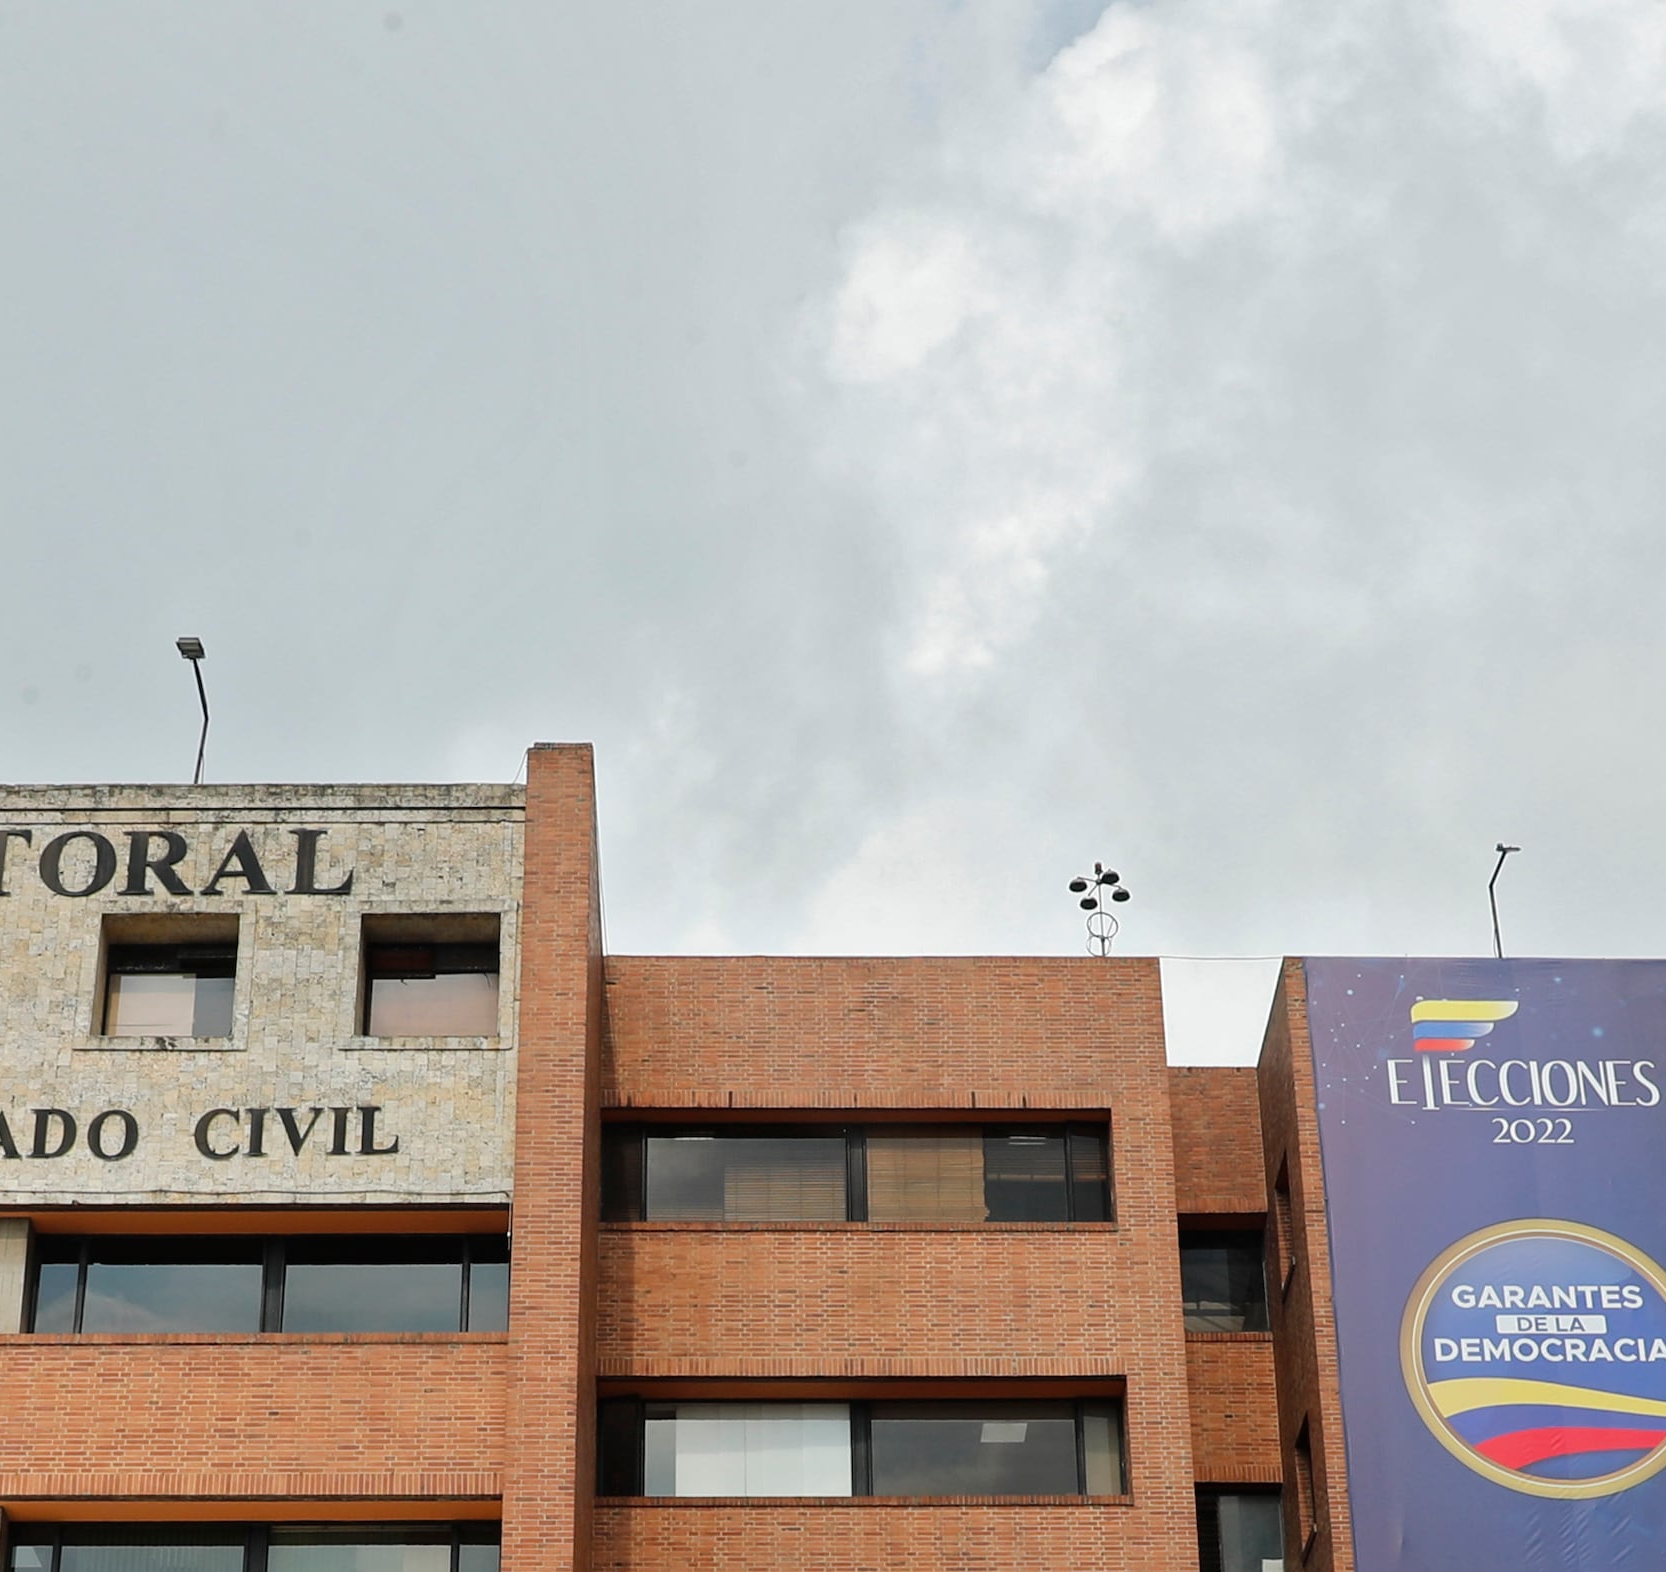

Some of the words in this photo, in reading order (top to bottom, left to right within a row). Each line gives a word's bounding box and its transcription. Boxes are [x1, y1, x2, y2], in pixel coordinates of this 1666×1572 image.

[194, 1105, 400, 1159] CIVIL
[1492, 1117, 1575, 1145] 2022
[1451, 1284, 1644, 1309] GARANTES
[1516, 1316, 1548, 1333] DE
[1555, 1316, 1586, 1333] LA
